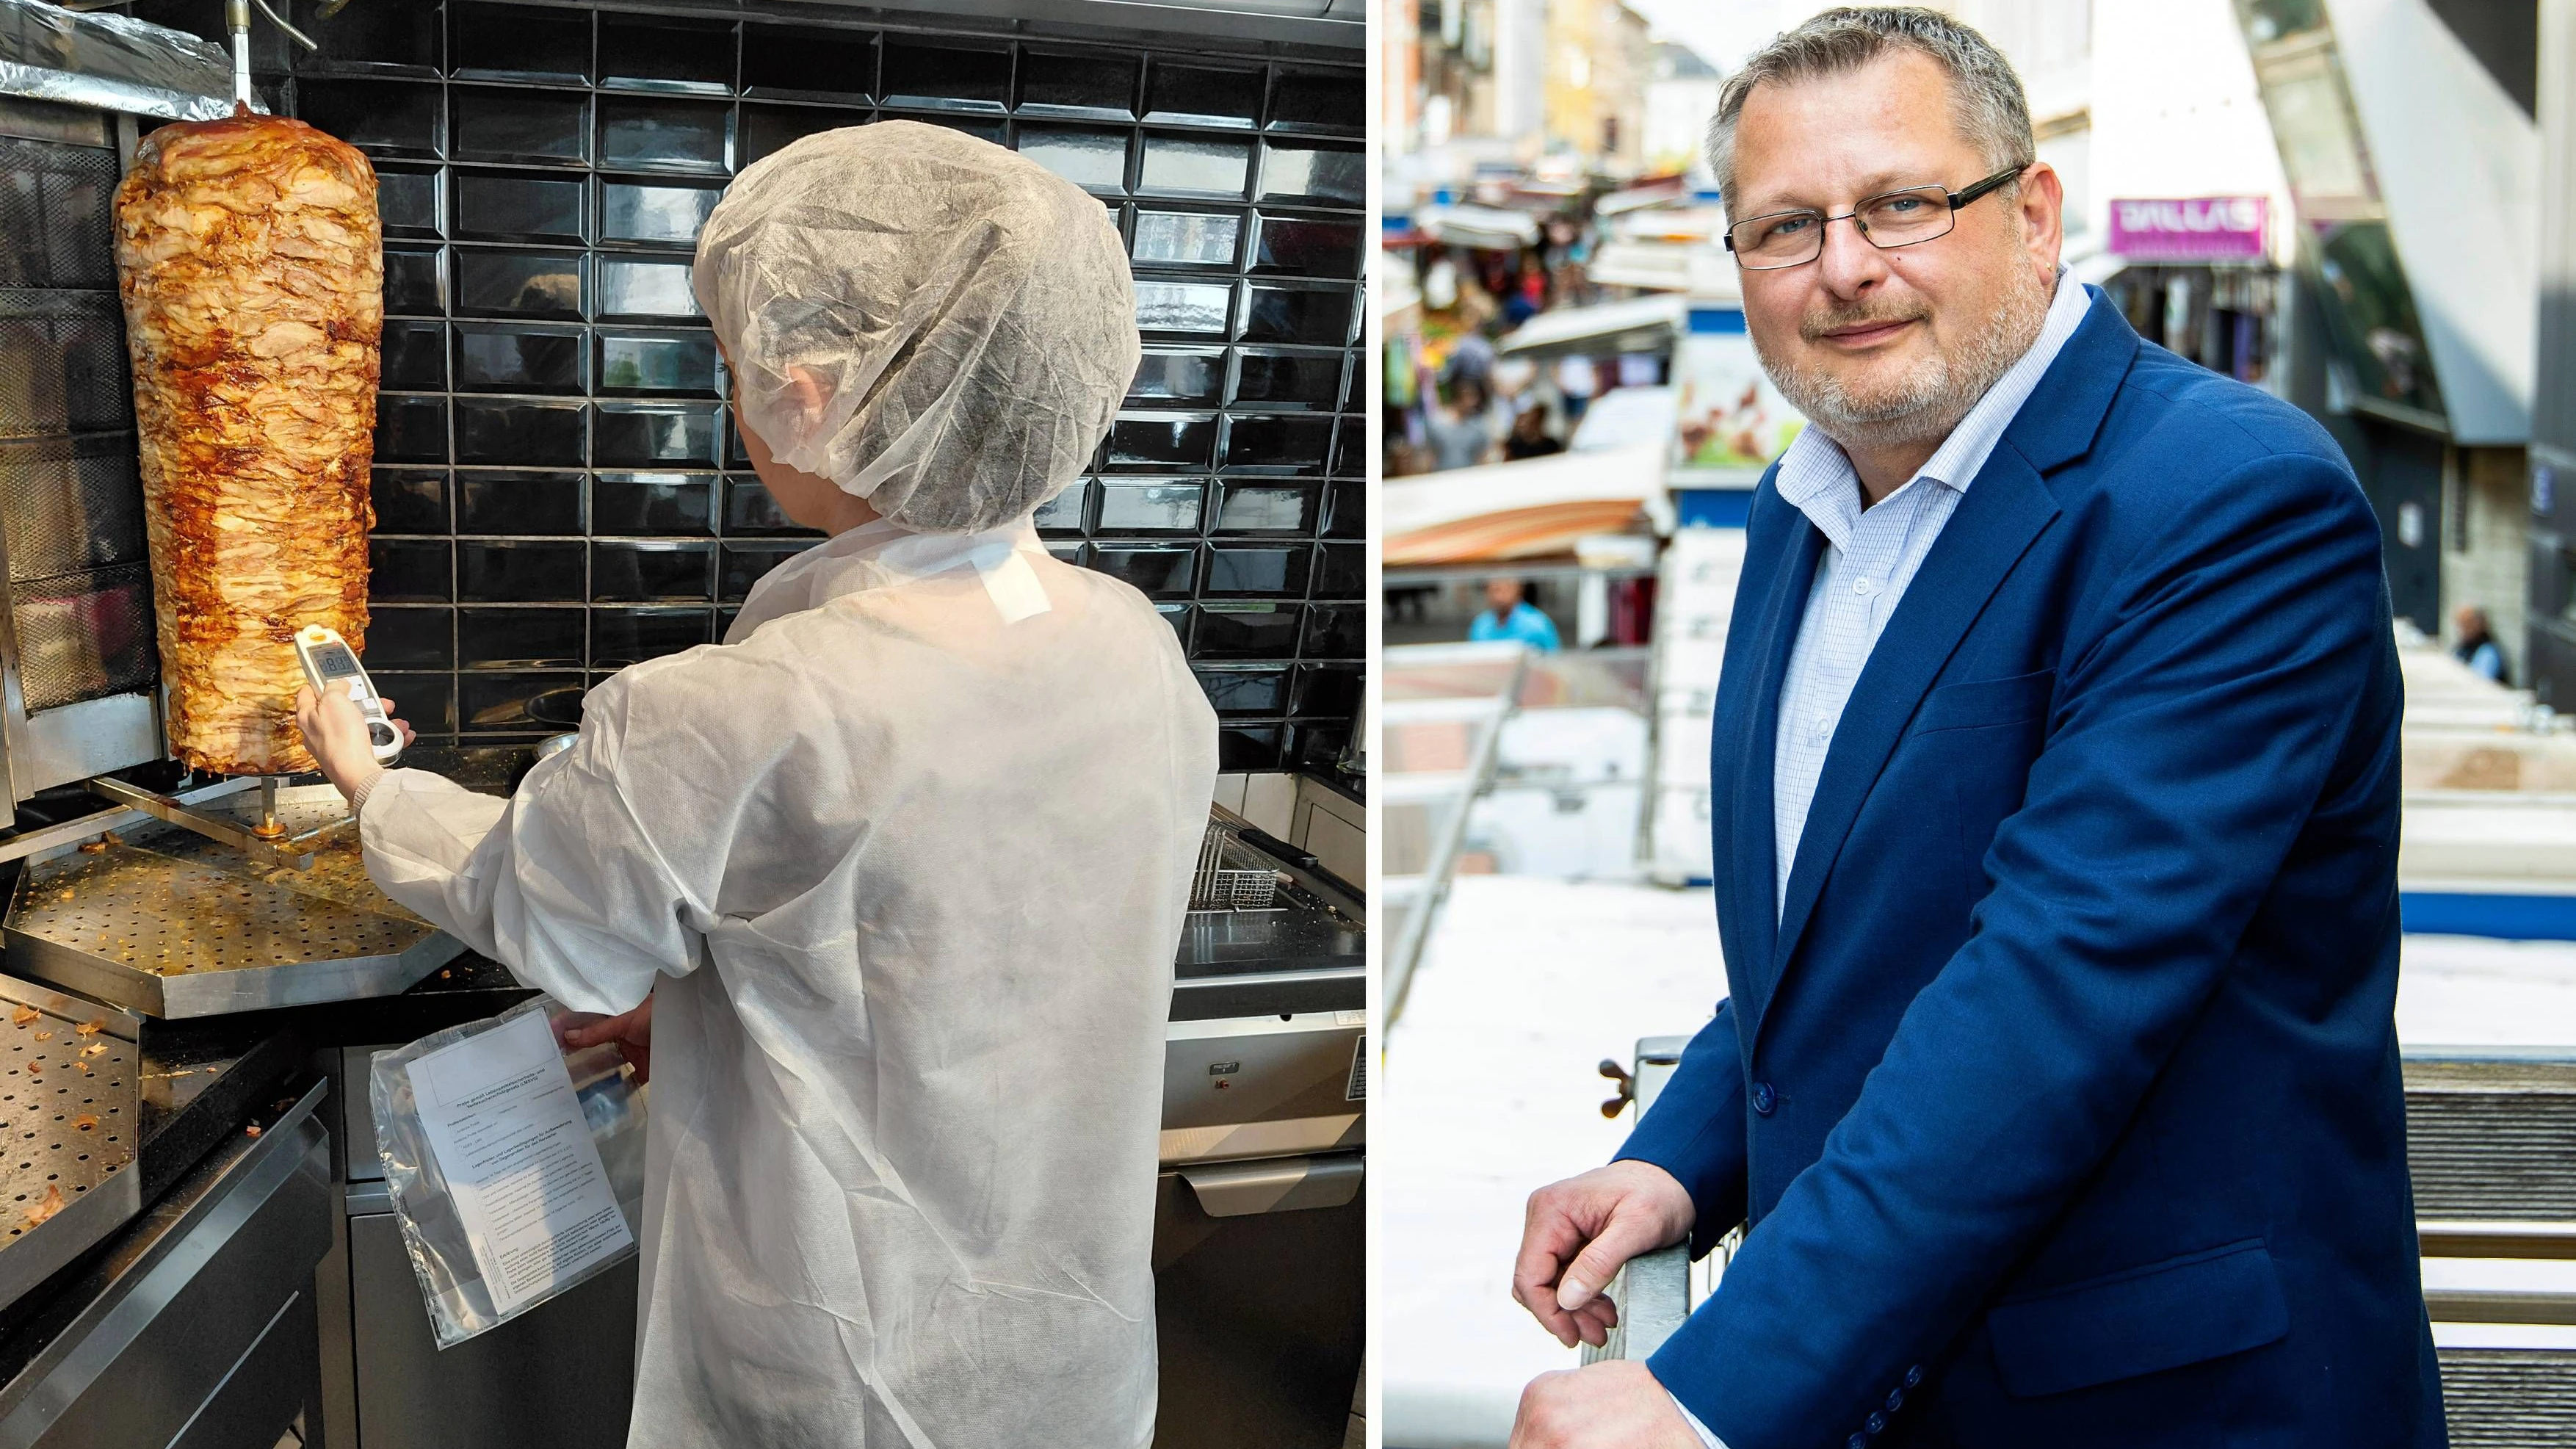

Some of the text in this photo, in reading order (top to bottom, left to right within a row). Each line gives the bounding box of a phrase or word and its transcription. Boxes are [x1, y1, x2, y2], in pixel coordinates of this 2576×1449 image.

[456, 1099, 470, 1108] Probe
[470, 1093, 485, 1103] gemäß
[471, 1154, 496, 1169] Lagerfristen
[503, 1134, 539, 1154] Lagerbedingungen
[544, 1119, 572, 1135] Aufbewahrung
